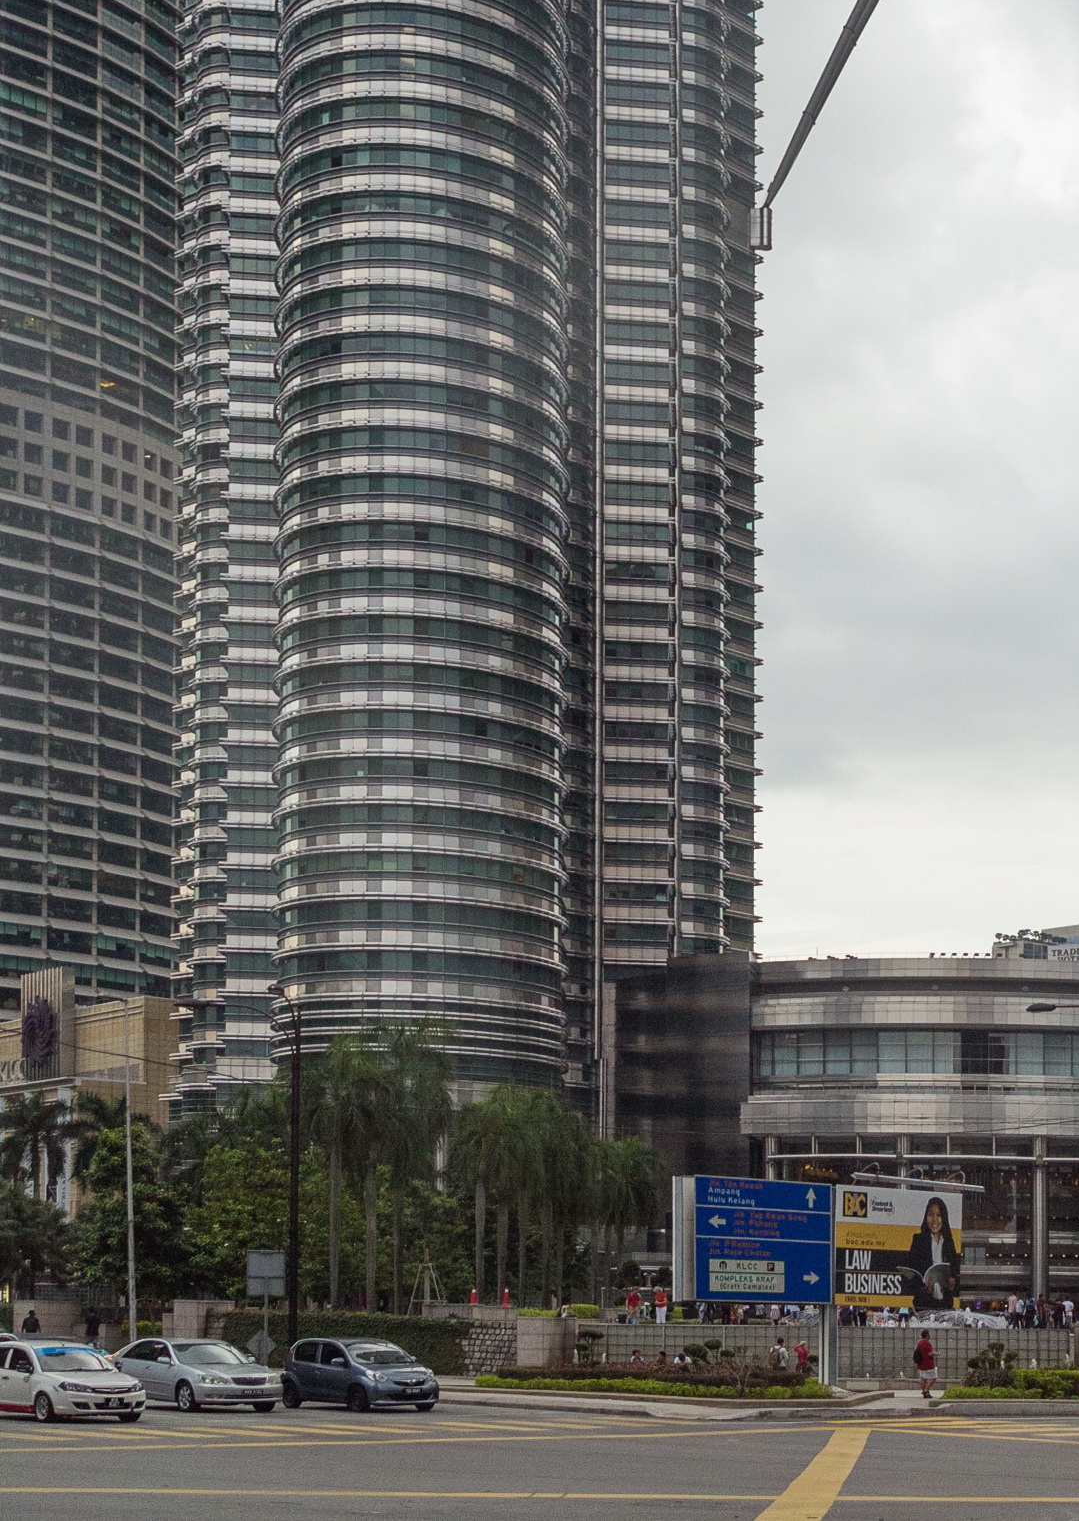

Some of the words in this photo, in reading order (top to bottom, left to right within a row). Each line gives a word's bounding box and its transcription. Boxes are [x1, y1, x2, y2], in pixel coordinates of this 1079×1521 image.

[708, 1187, 741, 1197] Ampang
[728, 1198, 755, 1206] Kelang
[845, 1249, 872, 1270] LAW
[736, 1262, 758, 1270] KLCC
[714, 1274, 753, 1283] KOMPLEKS
[755, 1275, 775, 1283] KRAF
[719, 1282, 741, 1291] (Craft
[742, 1283, 775, 1291] Complex)
[844, 1273, 902, 1294] BUSINESS
